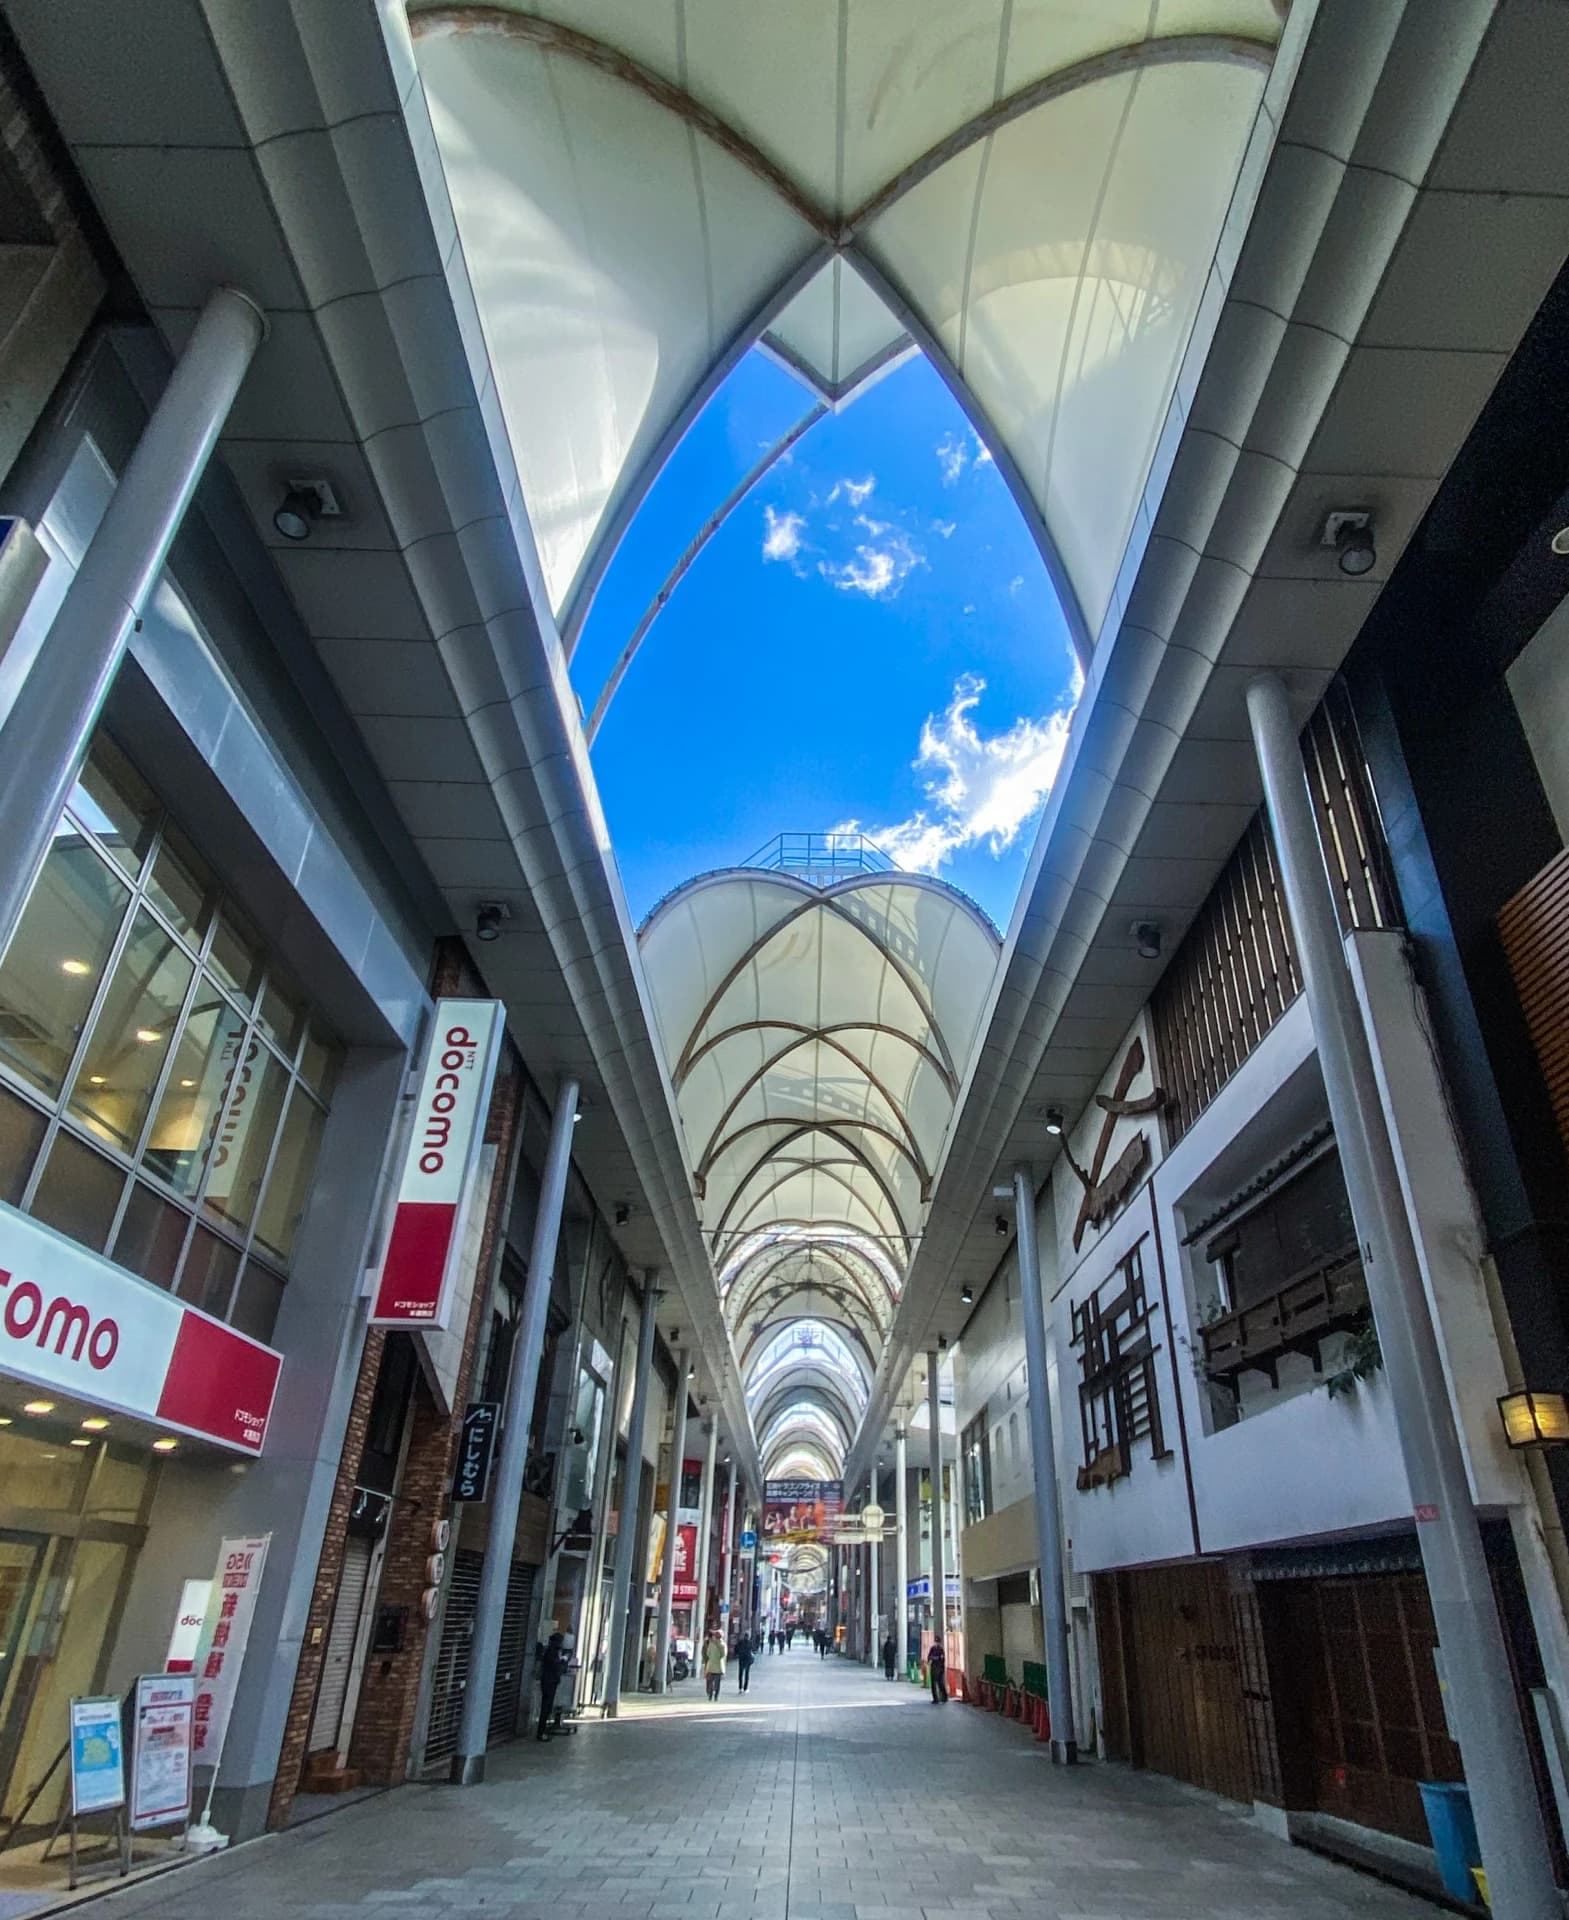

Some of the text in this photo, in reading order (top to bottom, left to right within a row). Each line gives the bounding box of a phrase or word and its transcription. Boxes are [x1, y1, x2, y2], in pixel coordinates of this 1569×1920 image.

[465, 1050, 477, 1071] NTT
[419, 1026, 478, 1174] docomo
[0, 1268, 119, 1370] omo
[394, 1300, 436, 1309] ドコモショップ
[234, 1408, 265, 1429] ドコモショップ
[460, 1427, 485, 1497] にしむら
